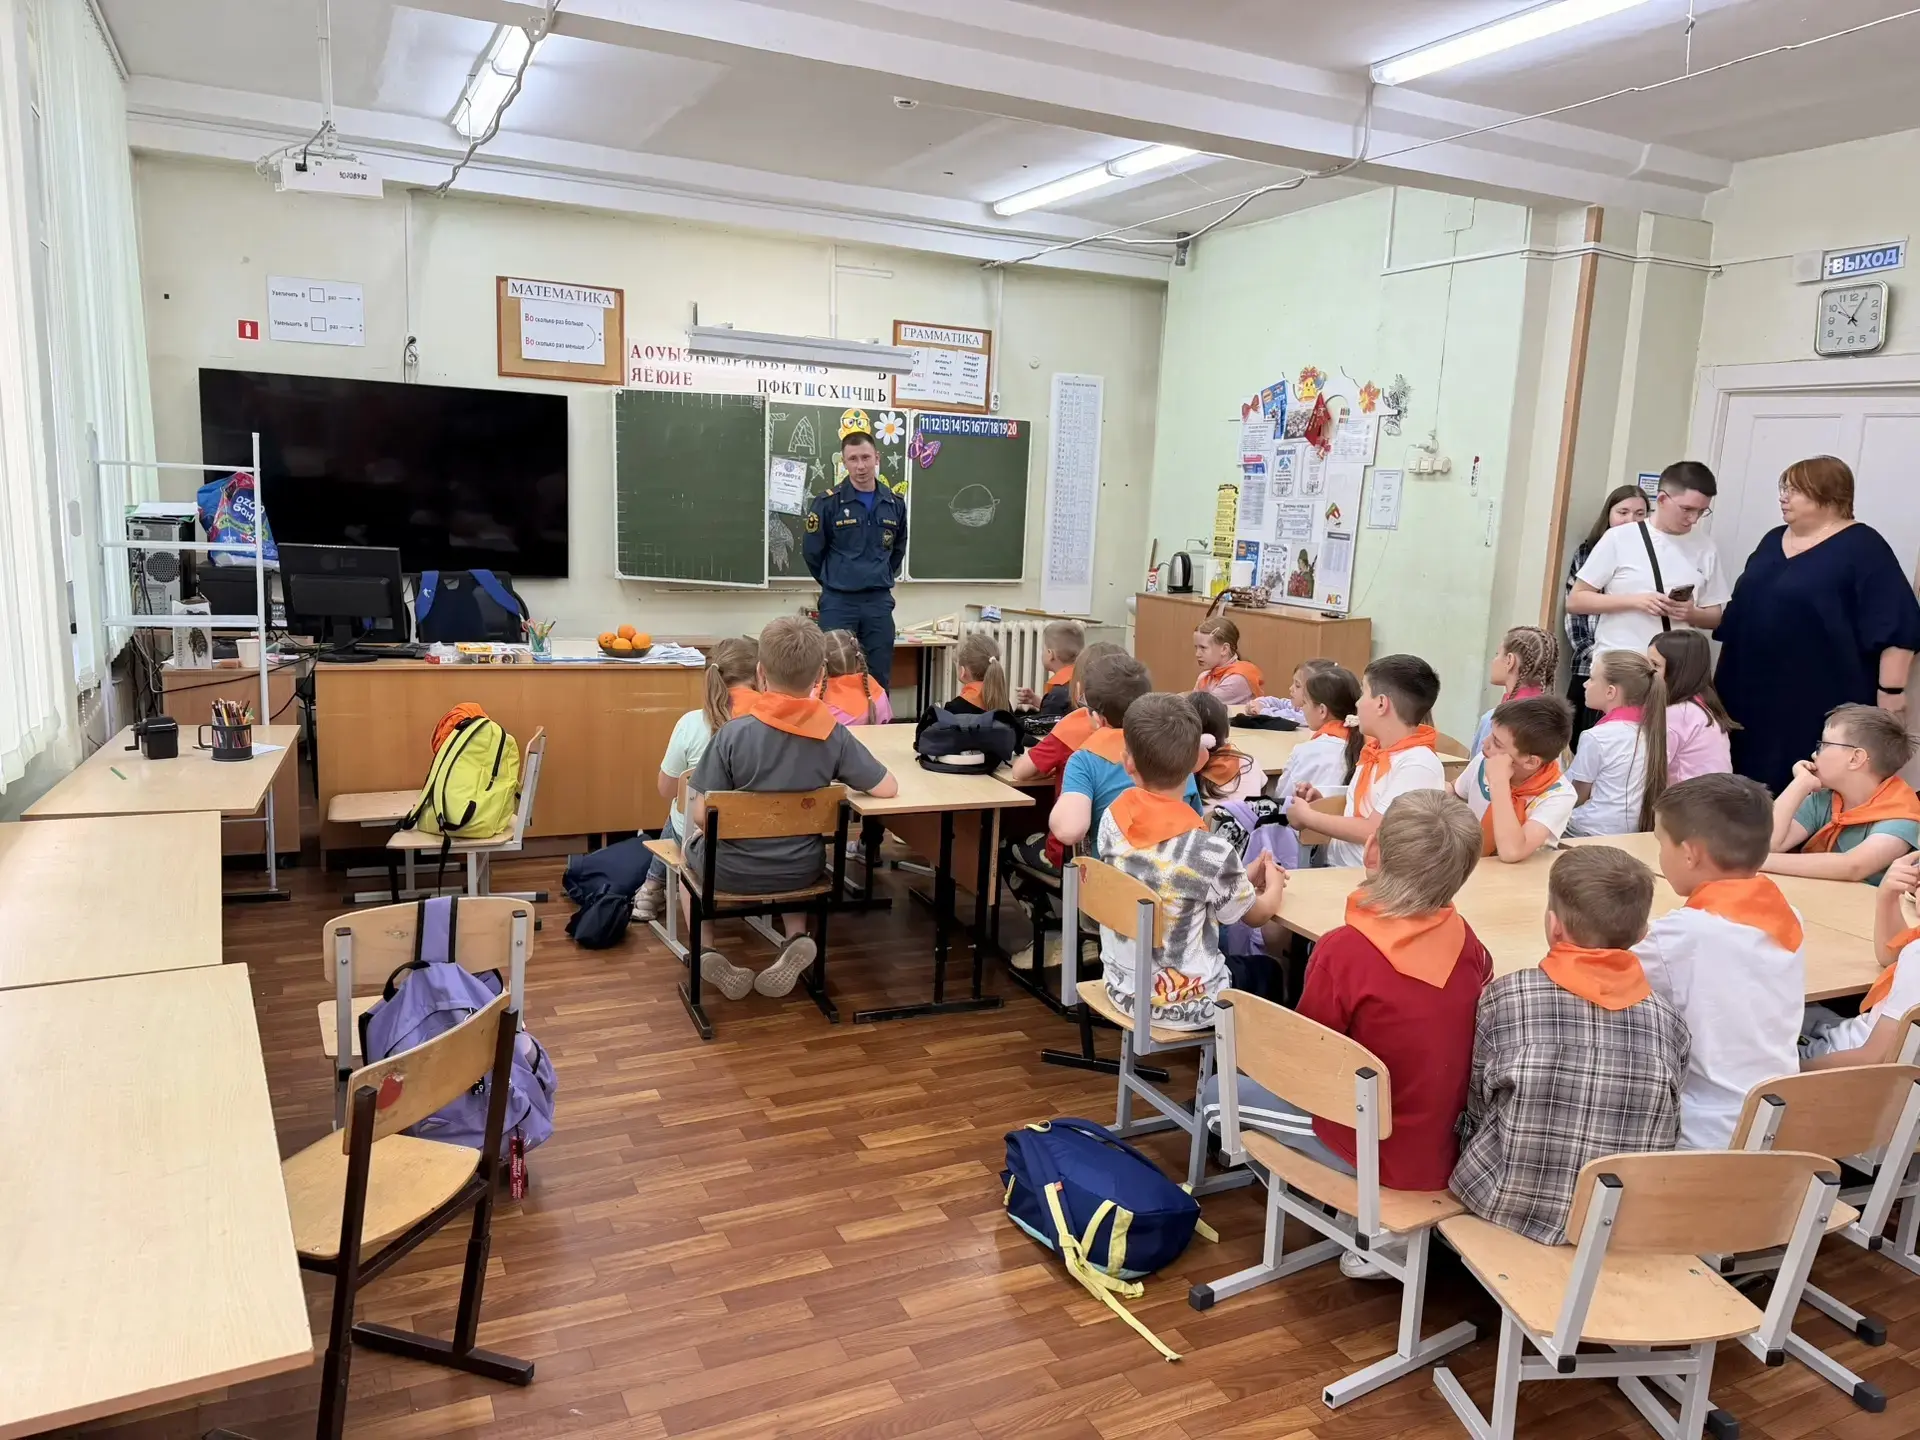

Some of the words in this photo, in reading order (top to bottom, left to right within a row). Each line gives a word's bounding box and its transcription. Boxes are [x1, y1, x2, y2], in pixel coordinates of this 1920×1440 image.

[1831, 248, 1897, 273] ВЫХОД
[511, 282, 612, 305] МАТЕМАТИКА
[1850, 293, 1859, 301] 12
[1840, 295, 1846, 303] 11
[1829, 304, 1838, 312] 10
[1871, 300, 1878, 308] 2
[525, 313, 534, 321] Во
[565, 318, 584, 327] больше
[1870, 312, 1878, 320] 3
[1828, 317, 1835, 325] 9
[903, 327, 980, 345] ГРАММАТИКА
[1827, 330, 1834, 338] 8
[525, 336, 534, 345] Во
[1836, 337, 1843, 345] 7
[1847, 336, 1855, 344] 6
[1859, 334, 1867, 343] 5
[921, 417, 929, 430] 11
[931, 418, 940, 430] 12
[941, 418, 950, 431] 13
[951, 419, 960, 432] 14
[961, 420, 970, 432] 15
[971, 420, 980, 433] 16
[980, 421, 989, 434] 17
[990, 422, 998, 434] 18
[999, 422, 1008, 435] 19
[1008, 422, 1017, 435] 20
[775, 471, 802, 481] ГРАМОТА
